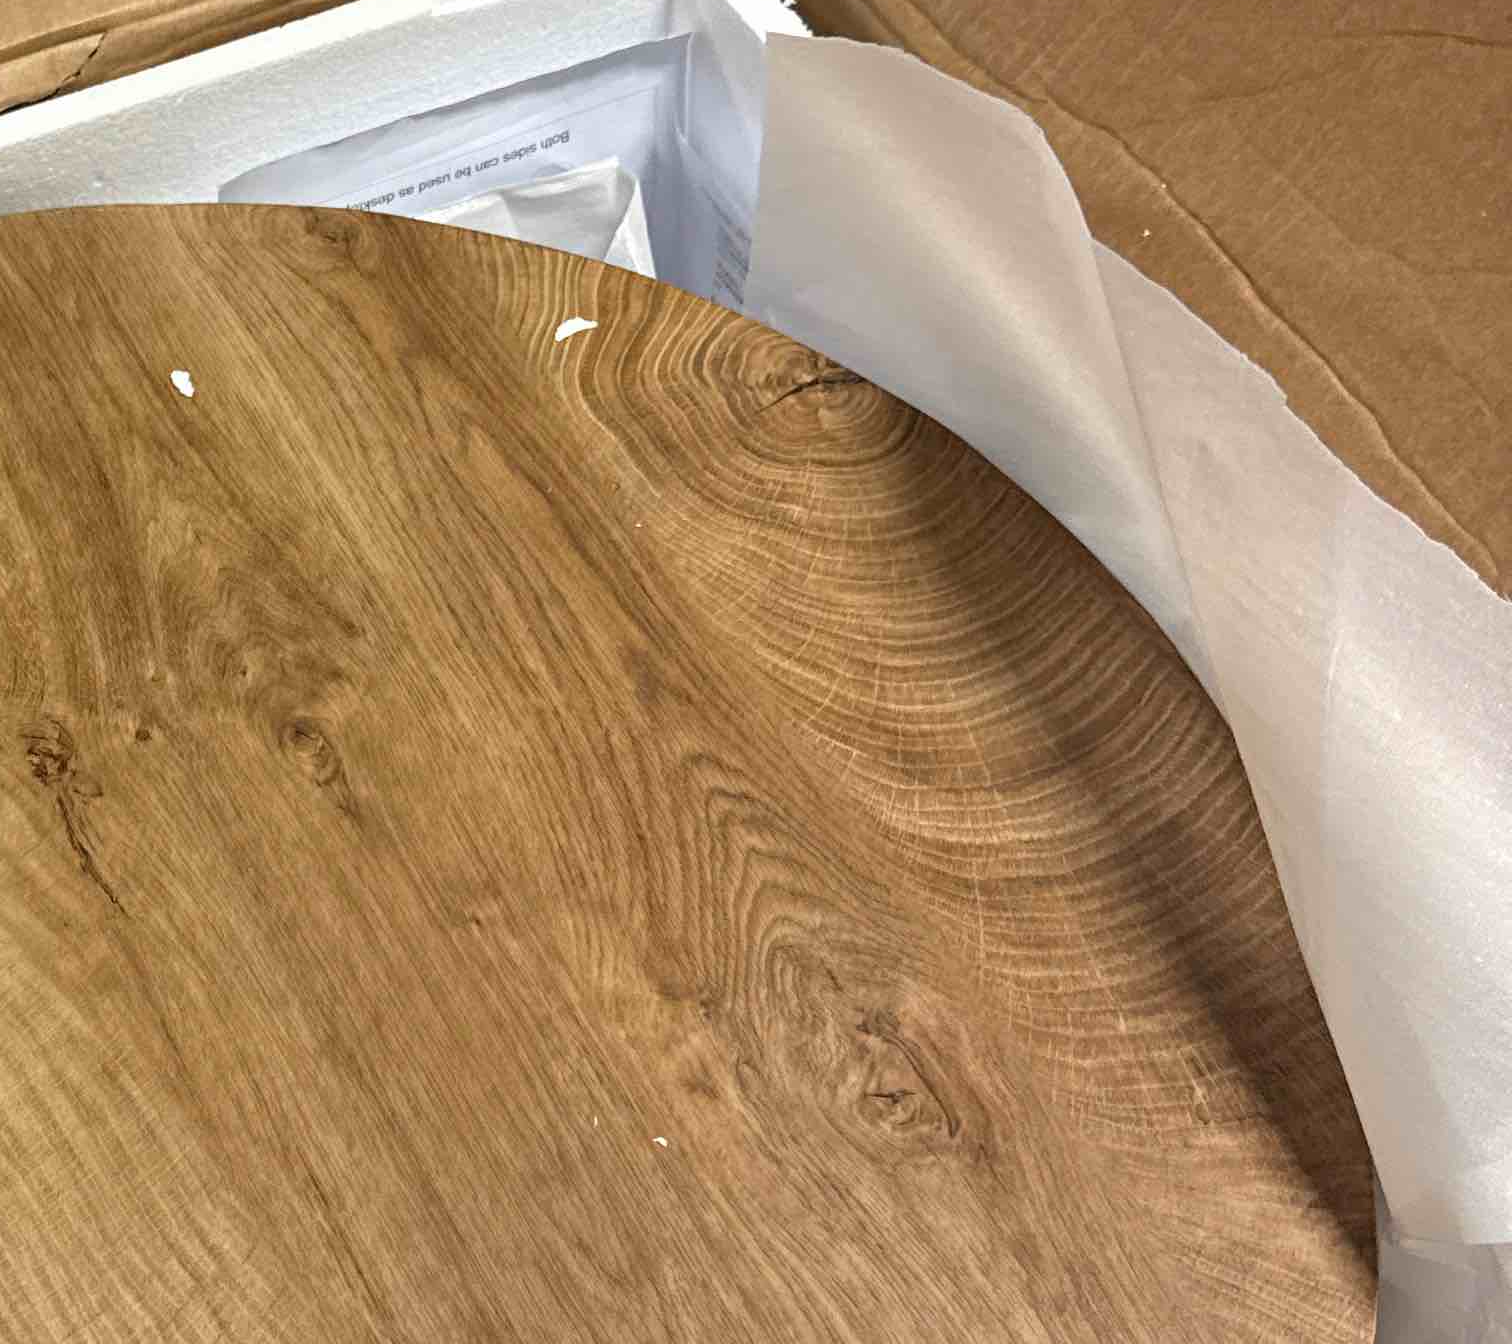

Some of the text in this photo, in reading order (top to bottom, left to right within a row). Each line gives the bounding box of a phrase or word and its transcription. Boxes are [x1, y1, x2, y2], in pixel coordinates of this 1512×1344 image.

[539, 128, 571, 150] Both
[501, 142, 538, 163] sides
[453, 165, 473, 182] be
[474, 158, 500, 173] can
[397, 185, 416, 198] as
[417, 172, 451, 194] used
